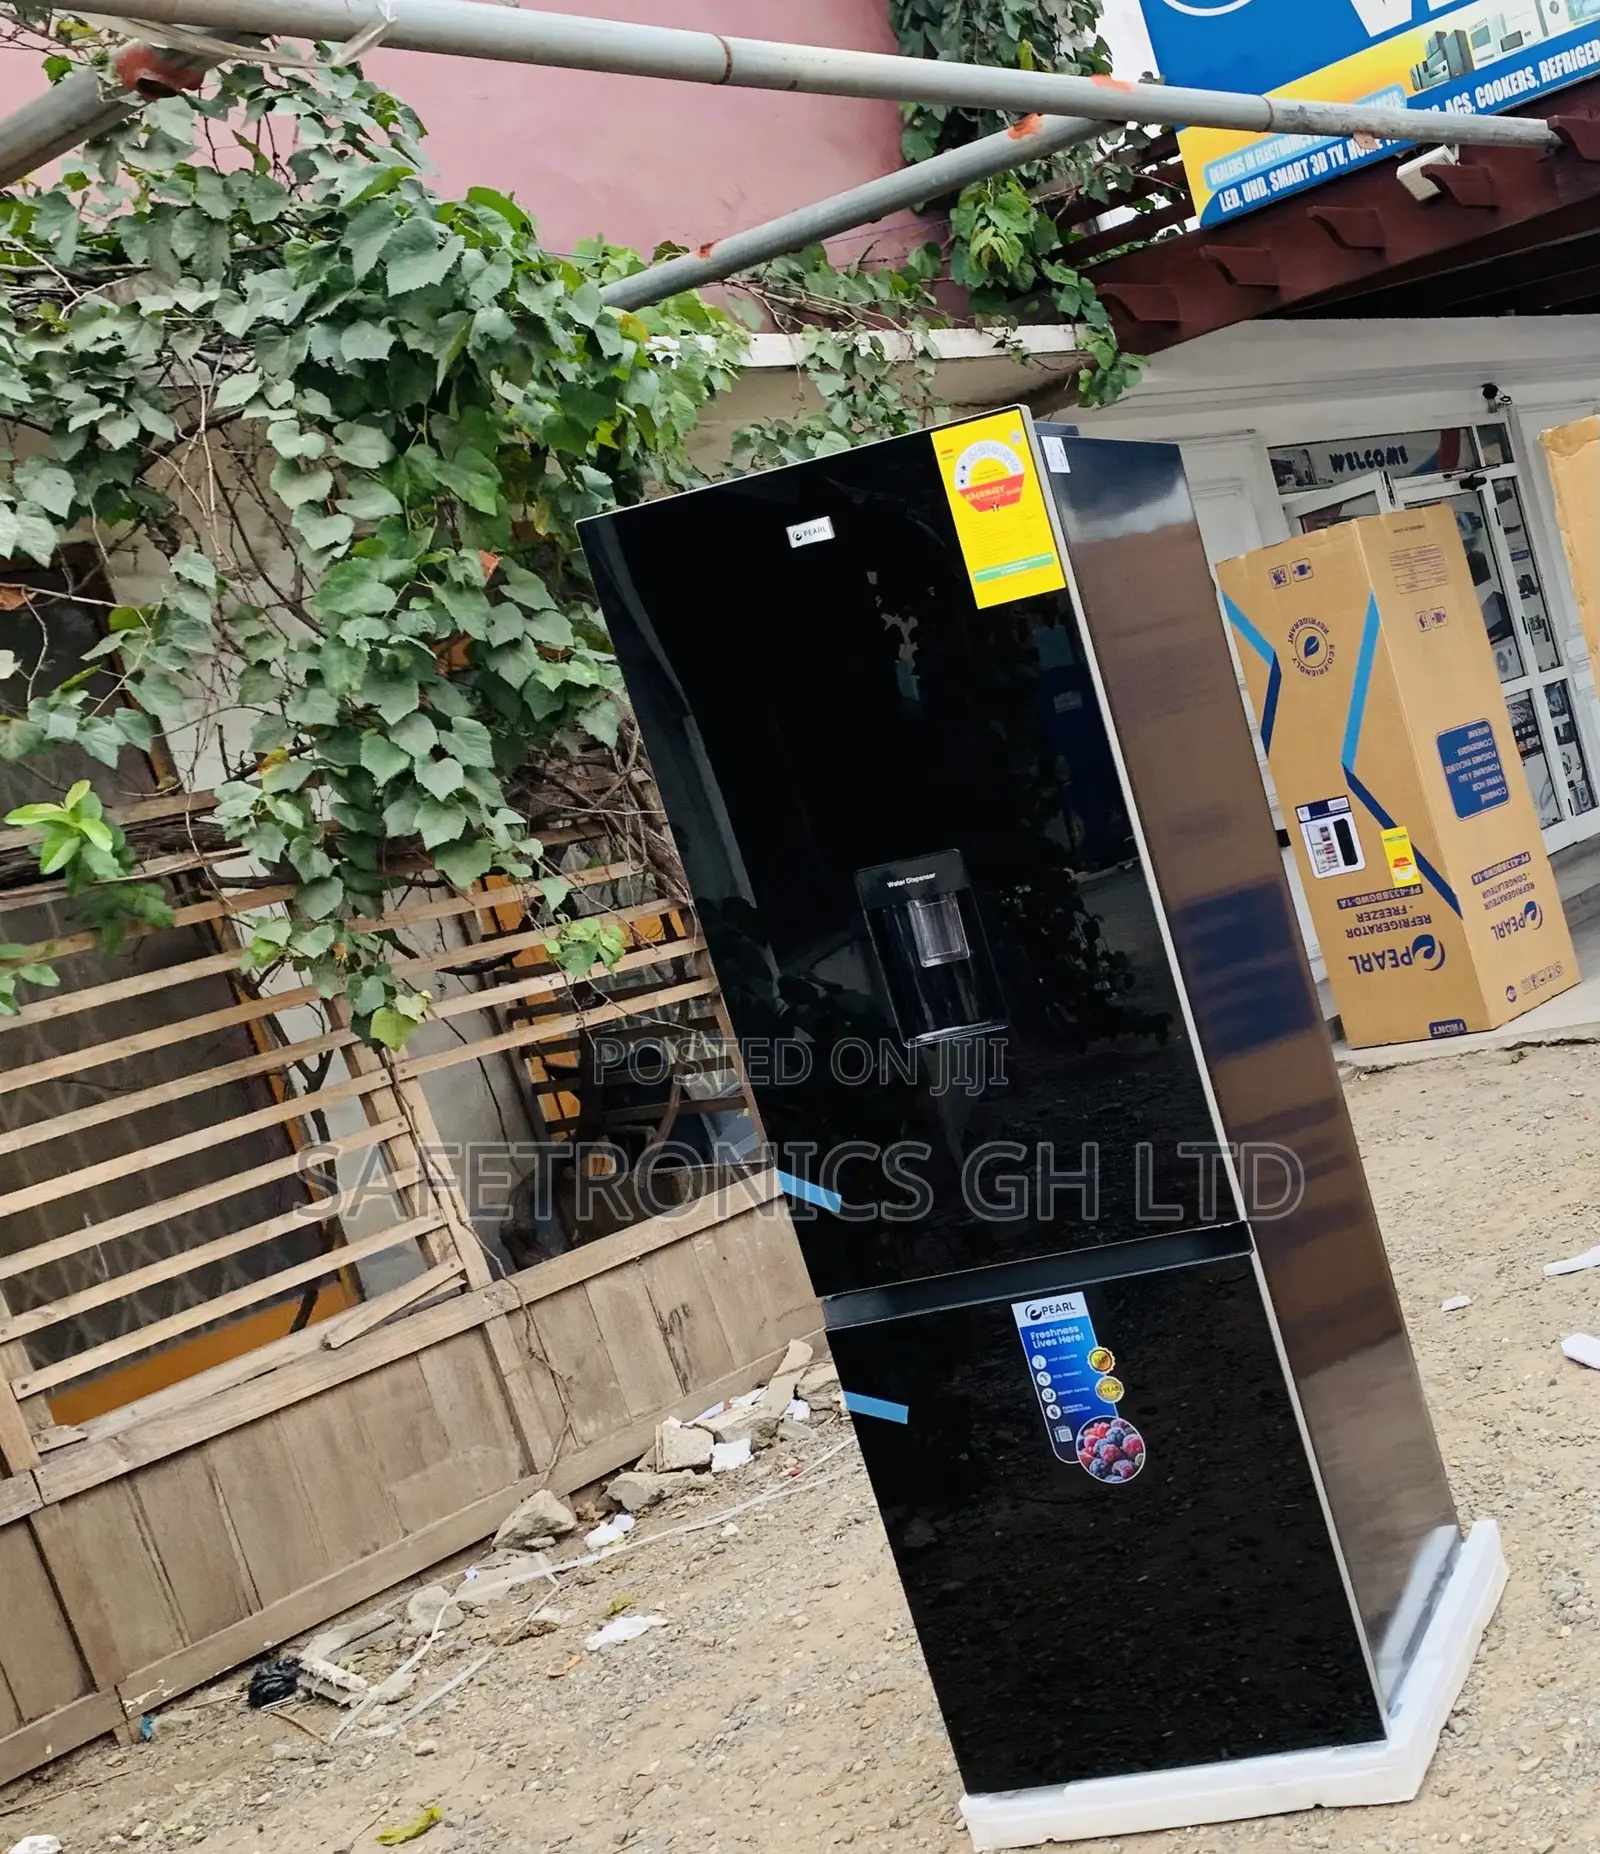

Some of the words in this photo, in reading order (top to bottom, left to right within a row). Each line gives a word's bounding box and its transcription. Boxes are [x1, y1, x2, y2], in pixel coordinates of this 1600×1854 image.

[1475, 66, 1540, 109] COOKERS,
[1243, 150, 1257, 170] IN
[1218, 188, 1244, 212] LED,
[1241, 177, 1271, 203] UHD,
[1268, 159, 1310, 192] SMART
[1309, 152, 1329, 176] 3D
[1326, 143, 1349, 168] TV,
[1328, 444, 1409, 474] WELCOME
[803, 526, 826, 537] PEARL
[1287, 617, 1330, 645] REFRIGERANT
[887, 880, 906, 889] Water
[905, 873, 936, 885] Dispenser
[1356, 904, 1408, 923] FREEZER
[1345, 914, 1433, 939] REFRIGERATOR
[1490, 912, 1526, 940] PEARL
[1348, 946, 1414, 975] PEARL
[1432, 1022, 1464, 1035] FRONT
[1041, 1301, 1076, 1315] PEARL
[1030, 1325, 1080, 1341] Freshness
[1032, 1337, 1058, 1349] Lives
[1058, 1332, 1085, 1345] Here!
